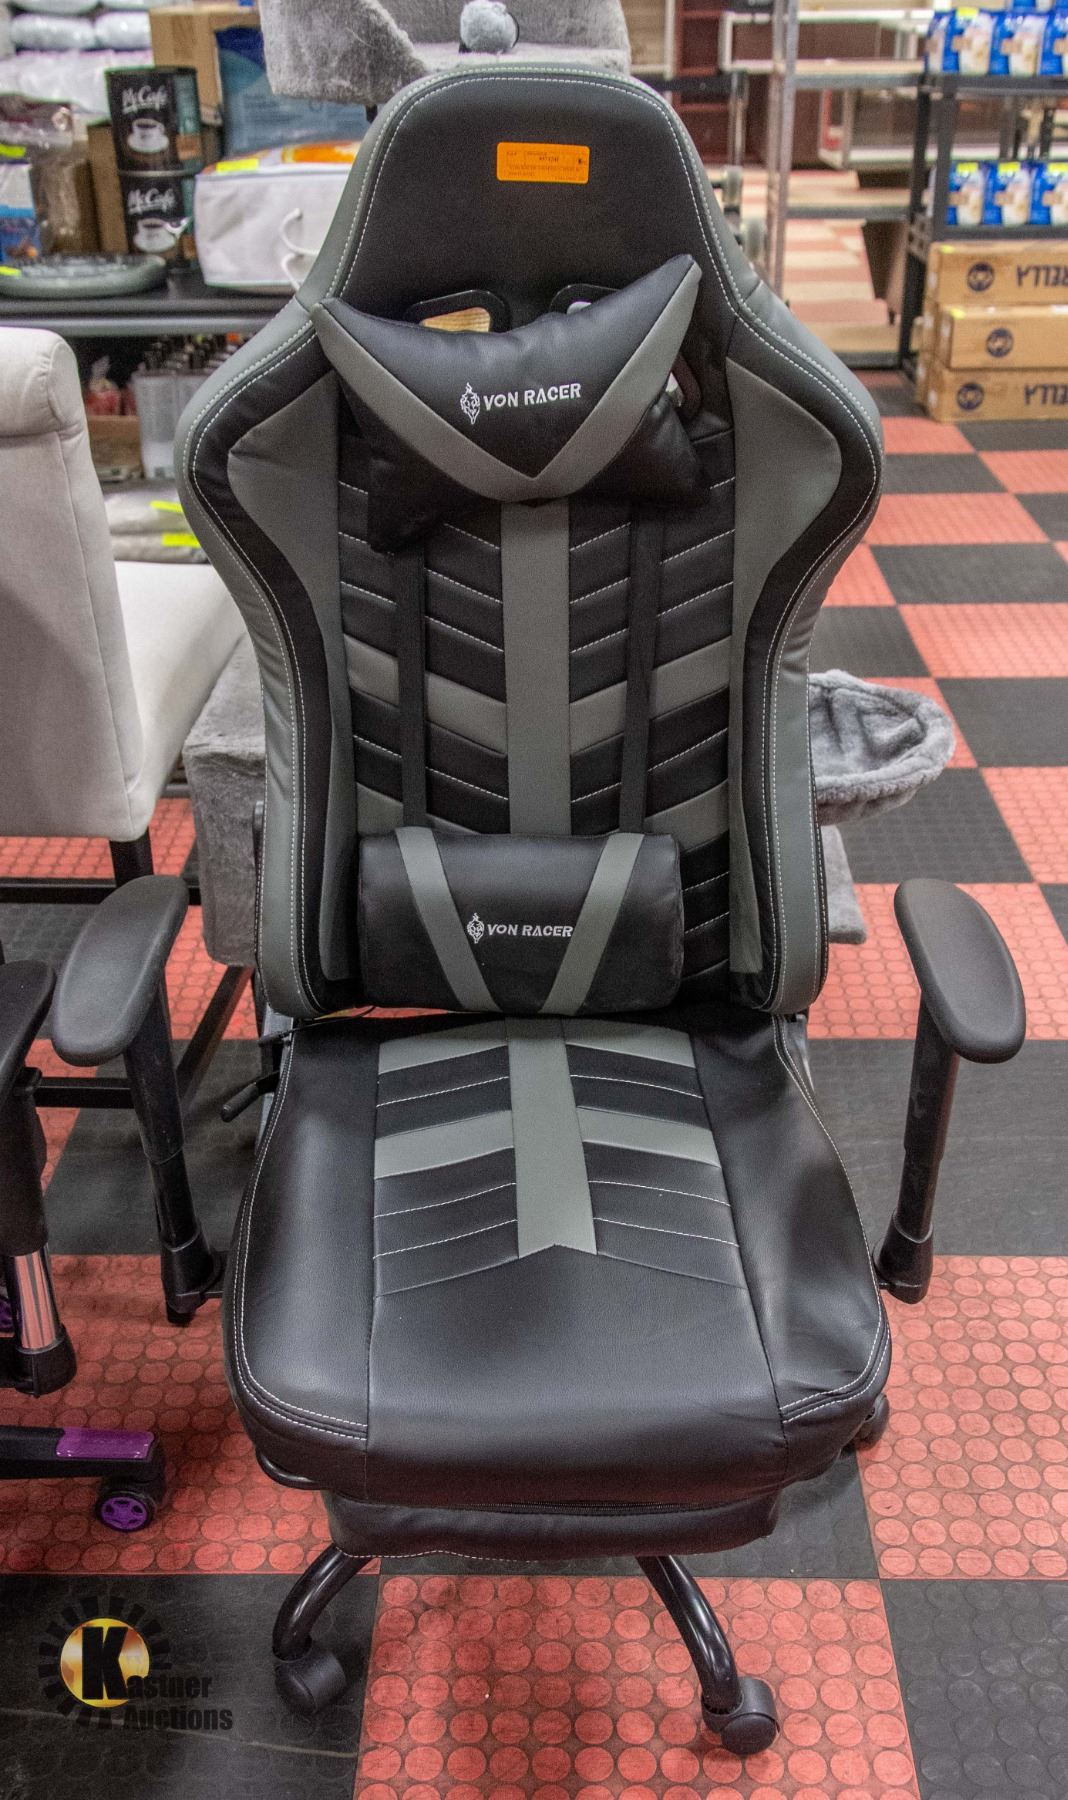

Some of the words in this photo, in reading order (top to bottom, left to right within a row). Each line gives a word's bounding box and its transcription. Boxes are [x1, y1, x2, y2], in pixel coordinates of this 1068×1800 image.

[483, 391, 519, 411] VON
[524, 383, 581, 406] RACER
[487, 924, 518, 937] VON
[522, 925, 574, 938] RACER
